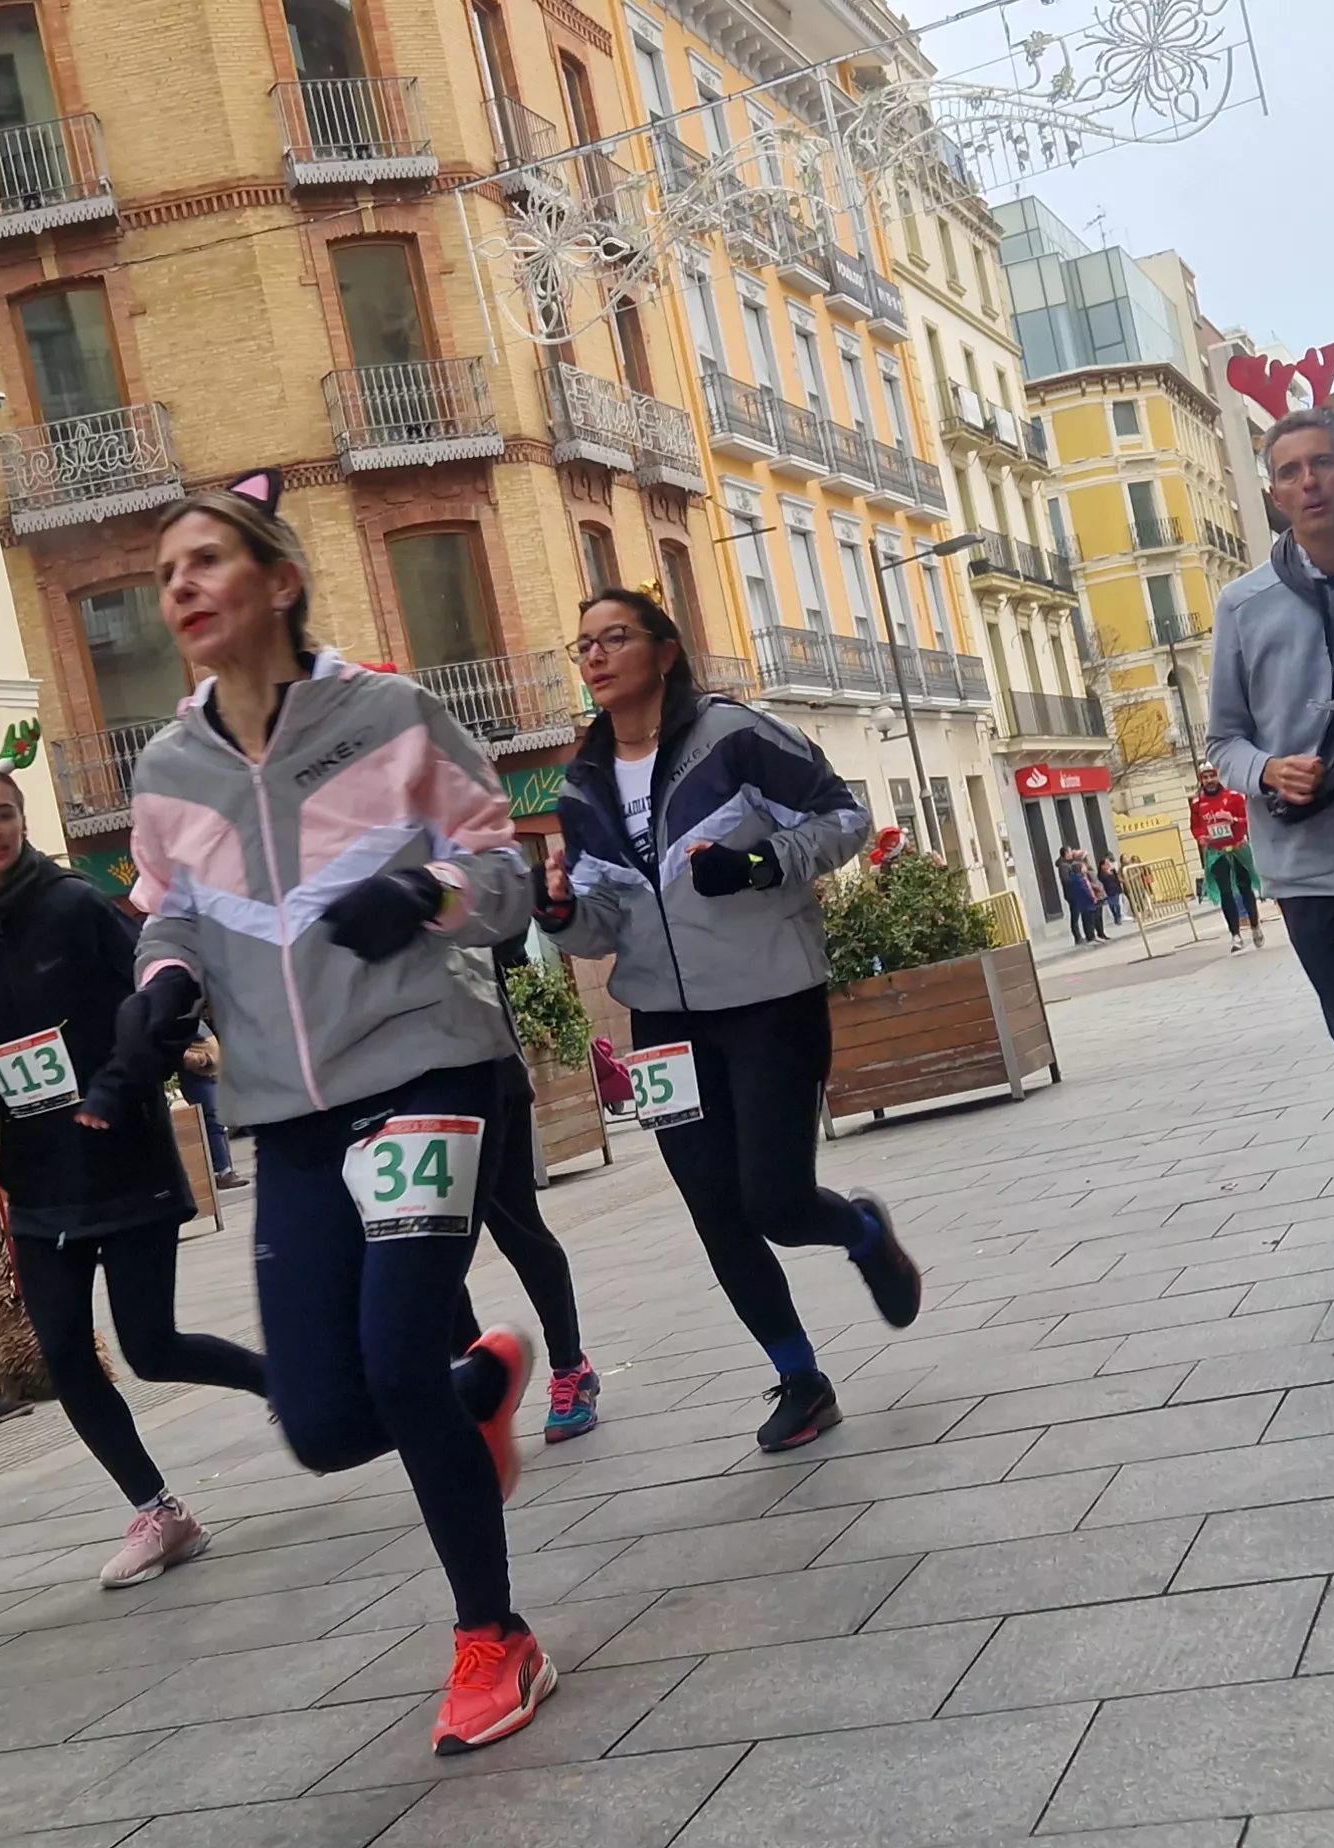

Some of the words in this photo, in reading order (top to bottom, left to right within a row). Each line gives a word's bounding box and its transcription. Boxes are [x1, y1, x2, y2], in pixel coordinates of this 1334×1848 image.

[1211, 825, 1230, 837] 101
[630, 1062, 674, 1109] 35
[373, 1139, 454, 1203] 34
